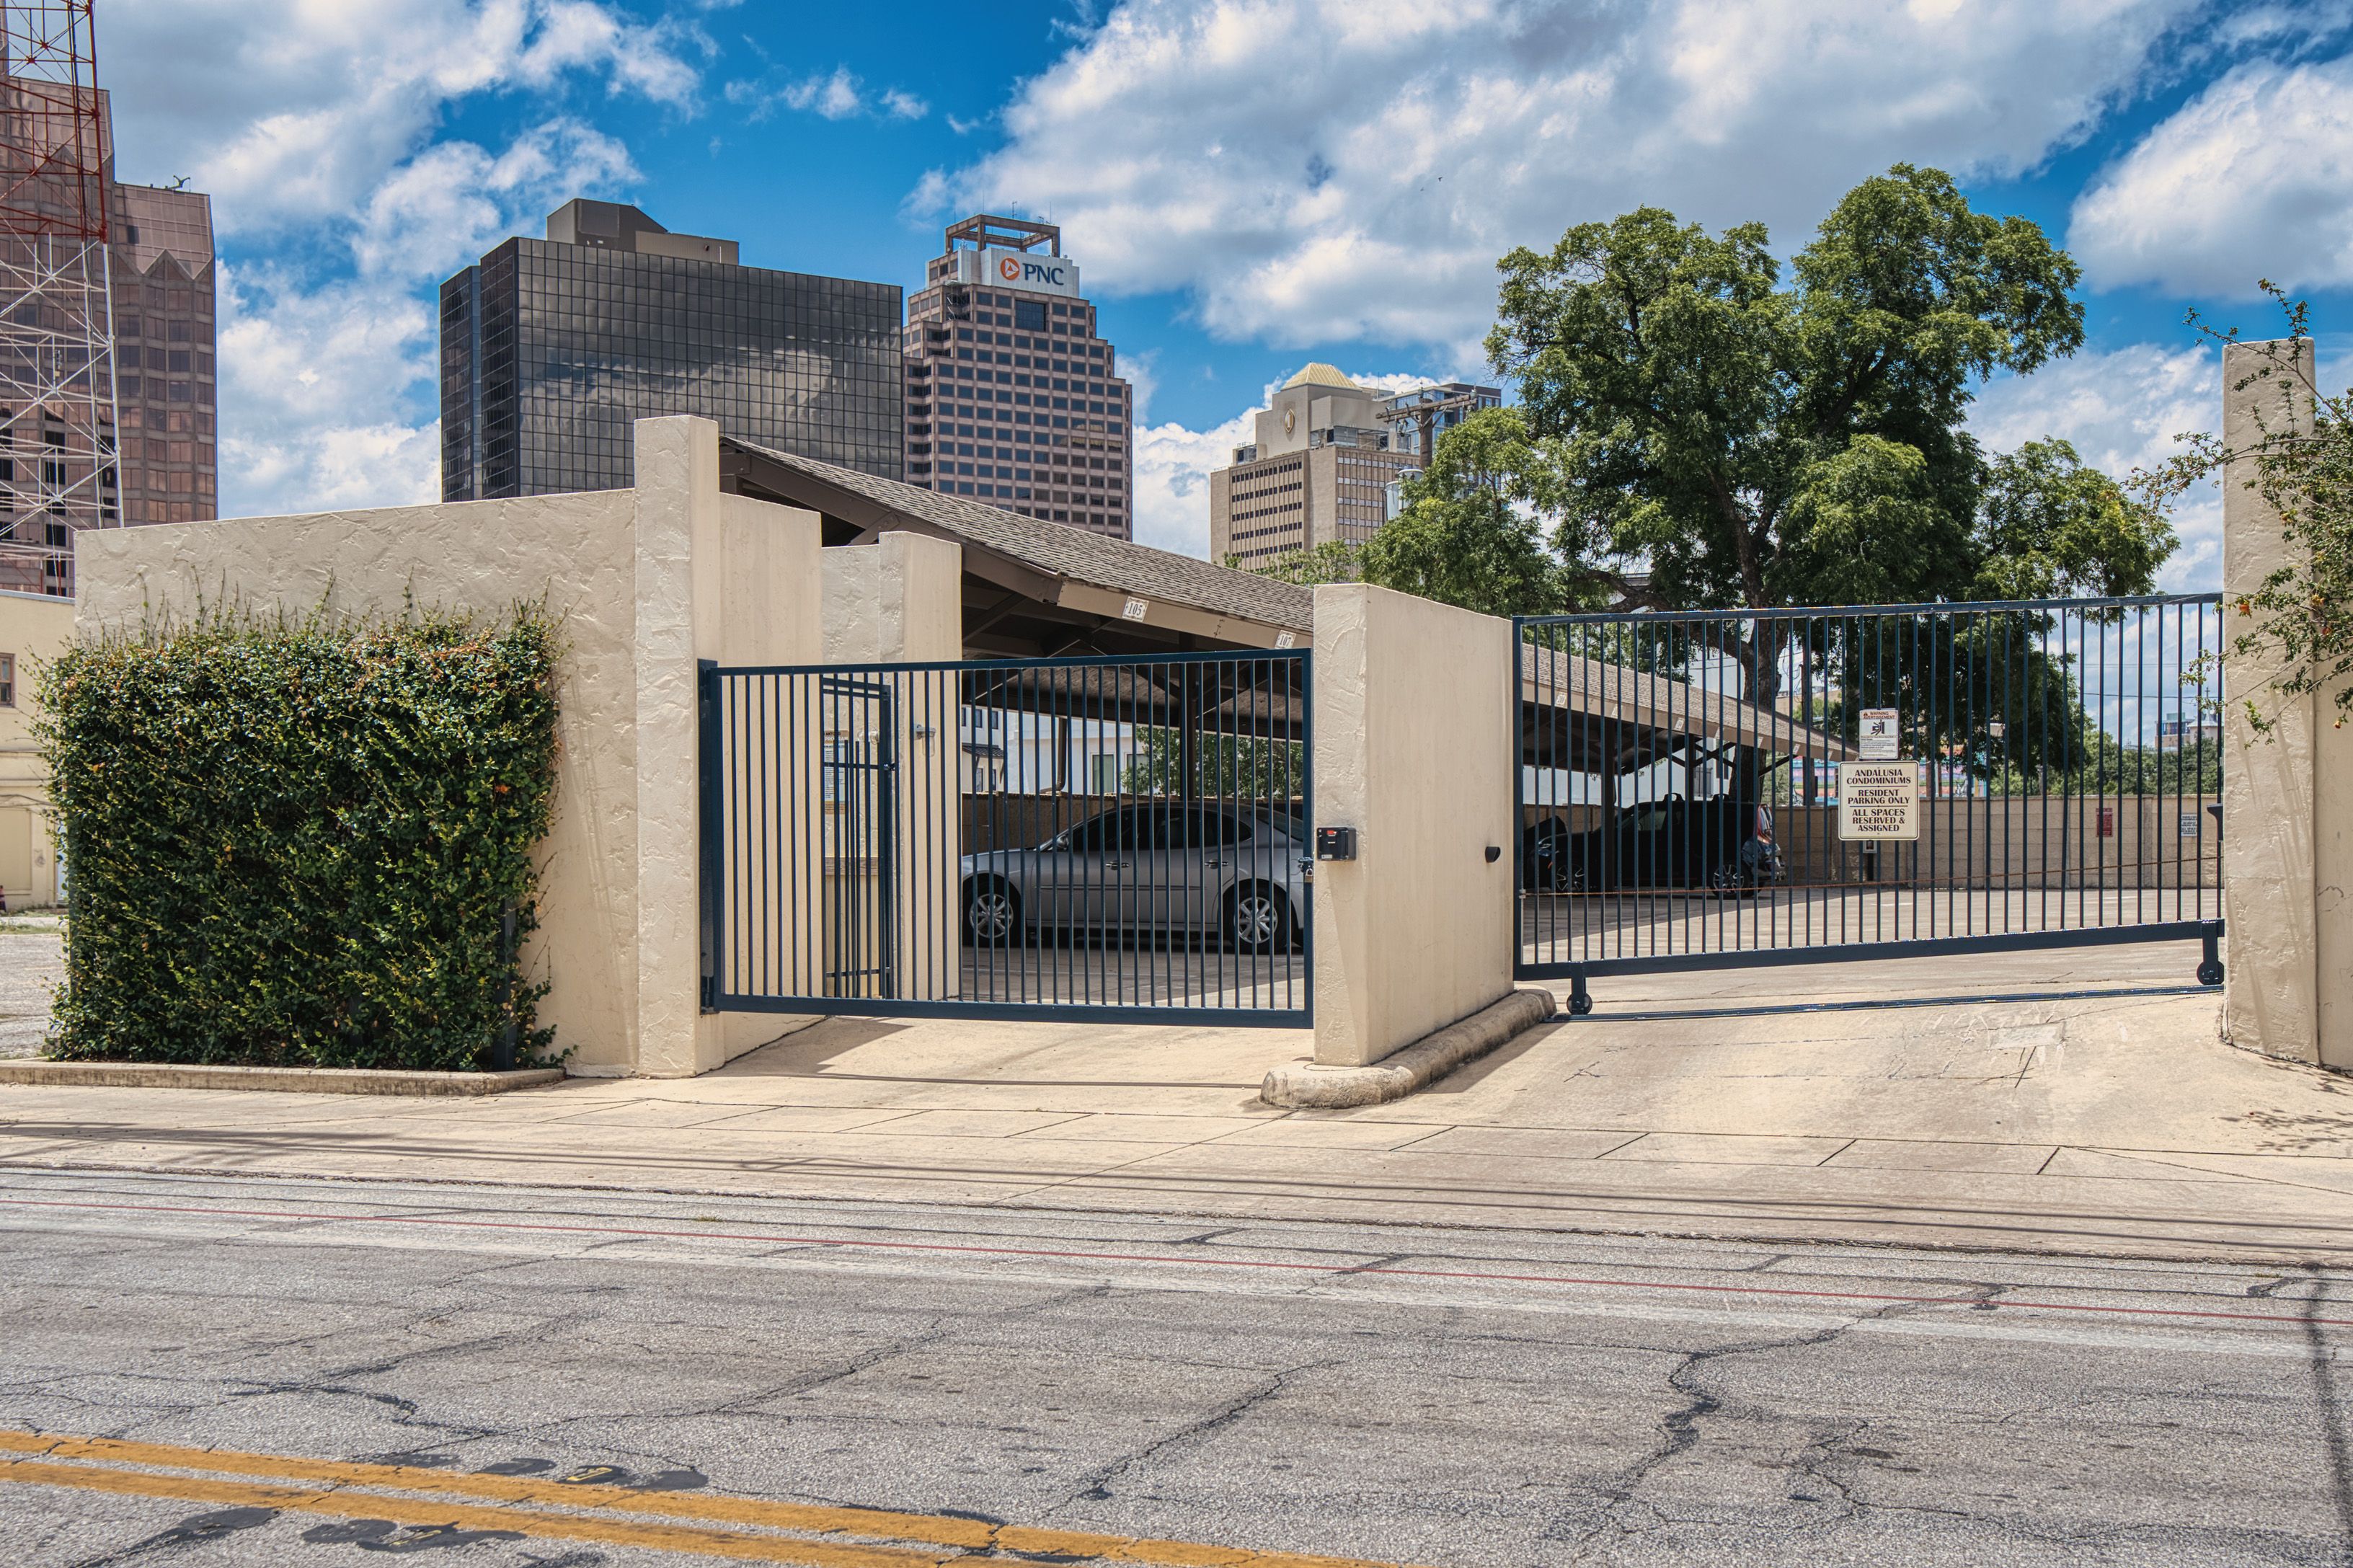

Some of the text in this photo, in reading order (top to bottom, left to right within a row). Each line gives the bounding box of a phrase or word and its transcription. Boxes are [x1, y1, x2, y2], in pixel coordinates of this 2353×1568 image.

[1022, 262, 1064, 285] PNC
[1128, 603, 1143, 616] 105
[1280, 635, 1292, 647] 107
